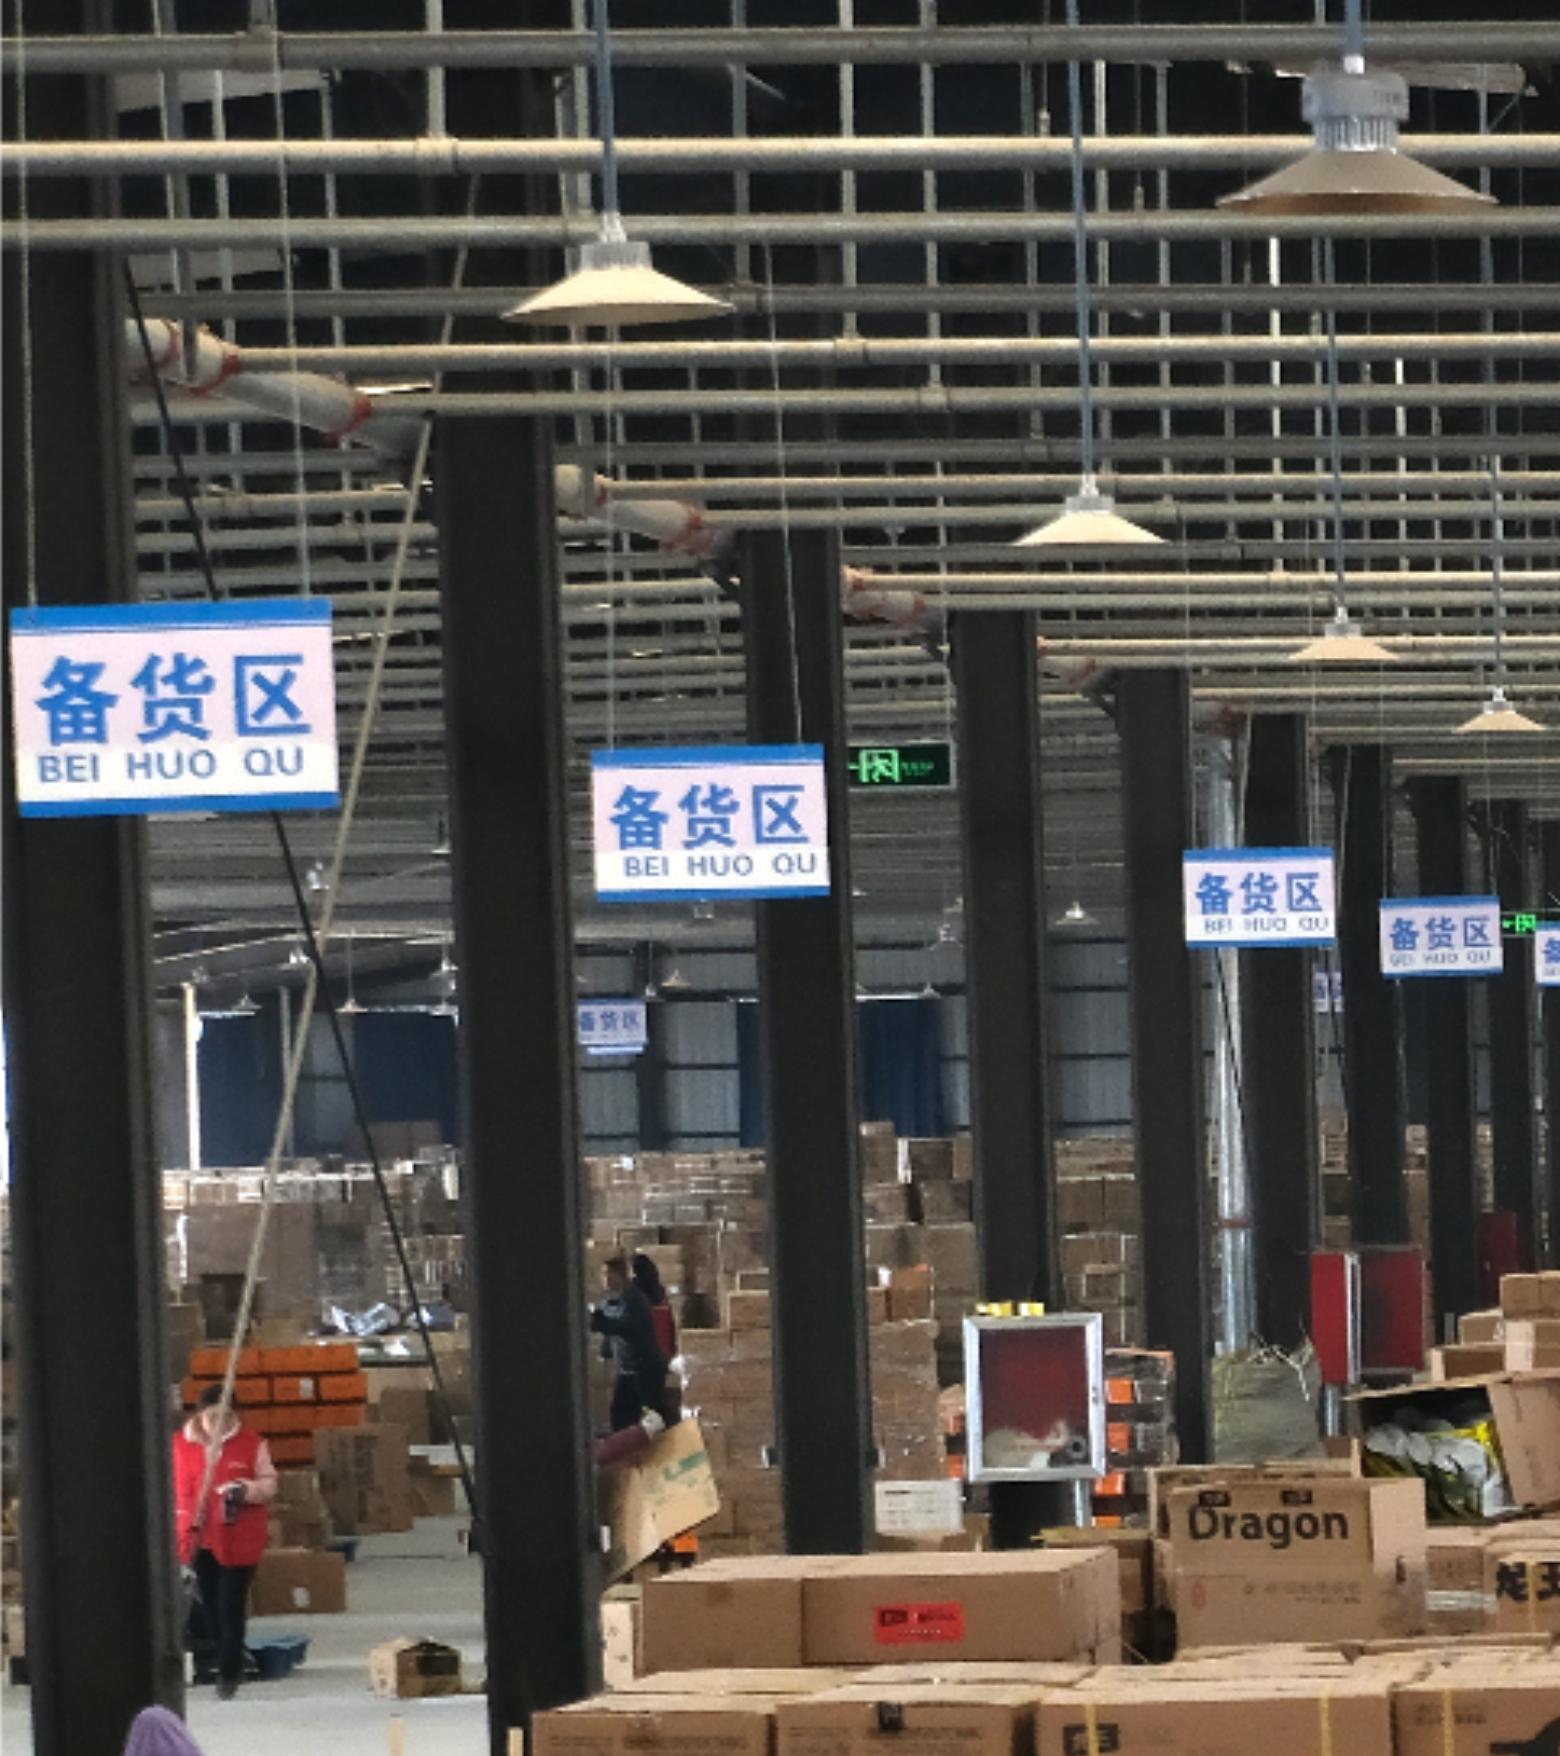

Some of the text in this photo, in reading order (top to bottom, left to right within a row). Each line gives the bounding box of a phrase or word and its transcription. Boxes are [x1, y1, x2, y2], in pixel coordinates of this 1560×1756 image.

[37, 654, 311, 745] 备货区
[37, 748, 304, 783] BEI HUO QU
[610, 785, 809, 850] 备货区
[624, 852, 816, 878] BEI HUO QU
[1195, 872, 1324, 917] 备货区
[1204, 915, 1330, 935] BEI HUO QU
[1388, 917, 1493, 951] 备货区
[1189, 1504, 1349, 1550] Dragon
